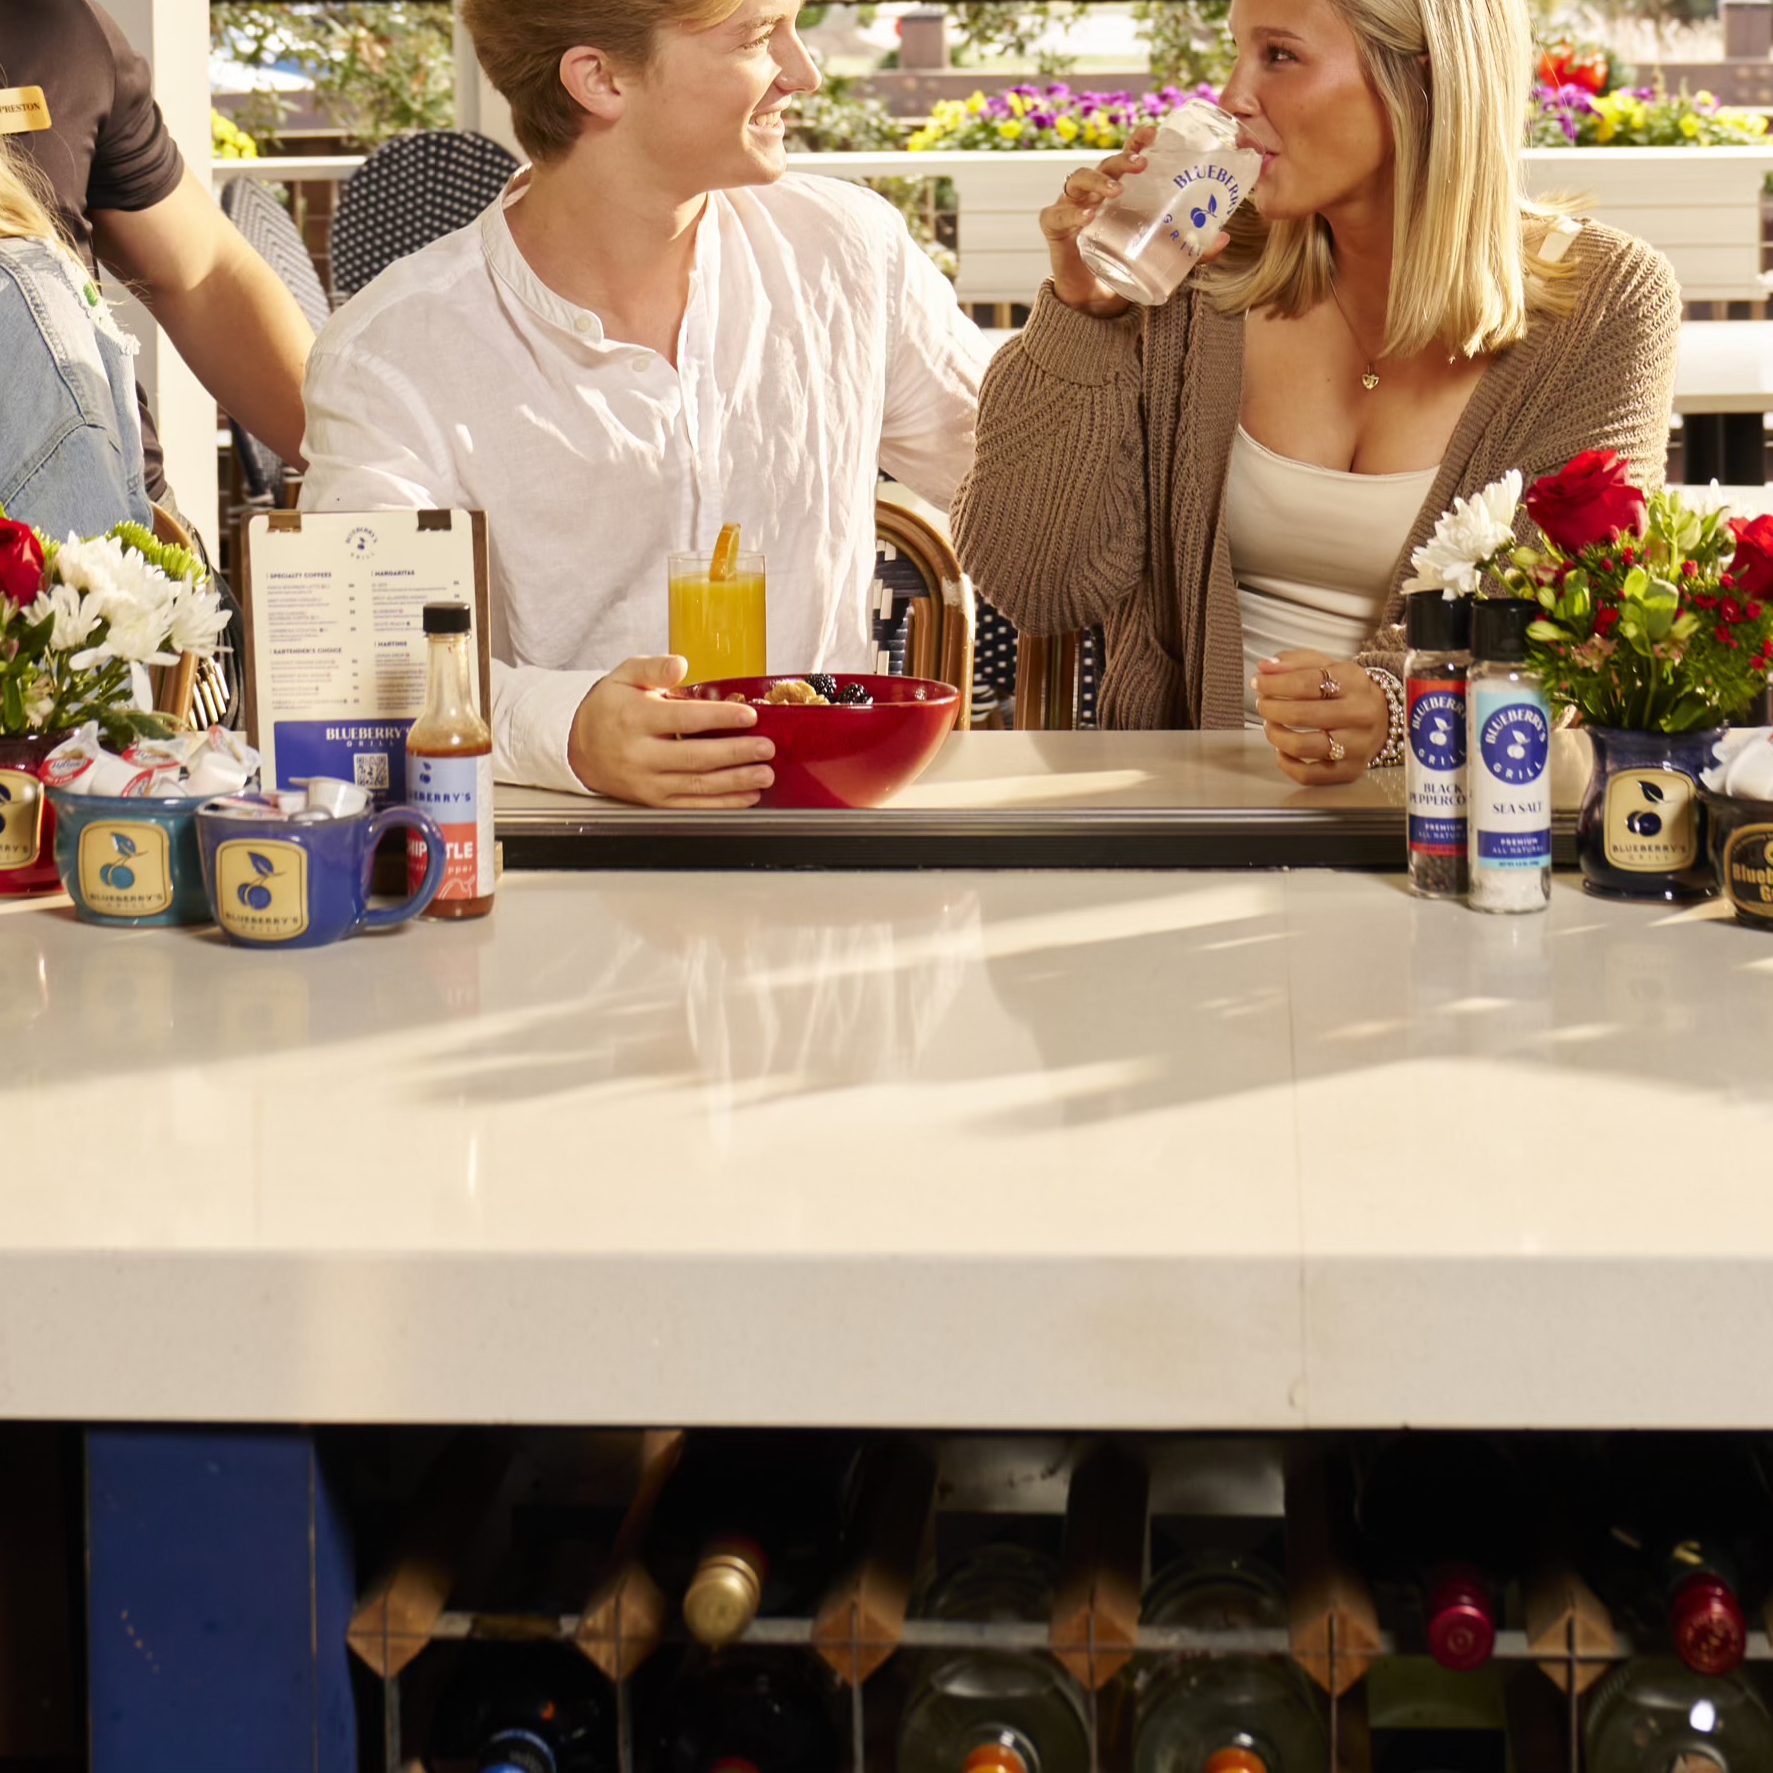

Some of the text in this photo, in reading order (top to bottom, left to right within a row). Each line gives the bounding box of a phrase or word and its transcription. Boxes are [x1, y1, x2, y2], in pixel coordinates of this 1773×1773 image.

[1163, 213, 1203, 257] GRILL
[1485, 708, 1546, 744] BLUEBERRY'S
[346, 739, 395, 748] GRILL
[1493, 761, 1542, 781] GRILL
[1423, 782, 1463, 795] BLACK
[1492, 801, 1543, 815] SEA SALT
[1500, 837, 1538, 846] PREMIUM
[407, 841, 474, 861] HIPTLE
[1493, 845, 1544, 855] ALL NATURAL
[1611, 843, 1688, 854] BLUEBERRY'S
[89, 892, 164, 903] BLUEBERRY'S
[226, 912, 299, 926] BLUEBERRY'S
